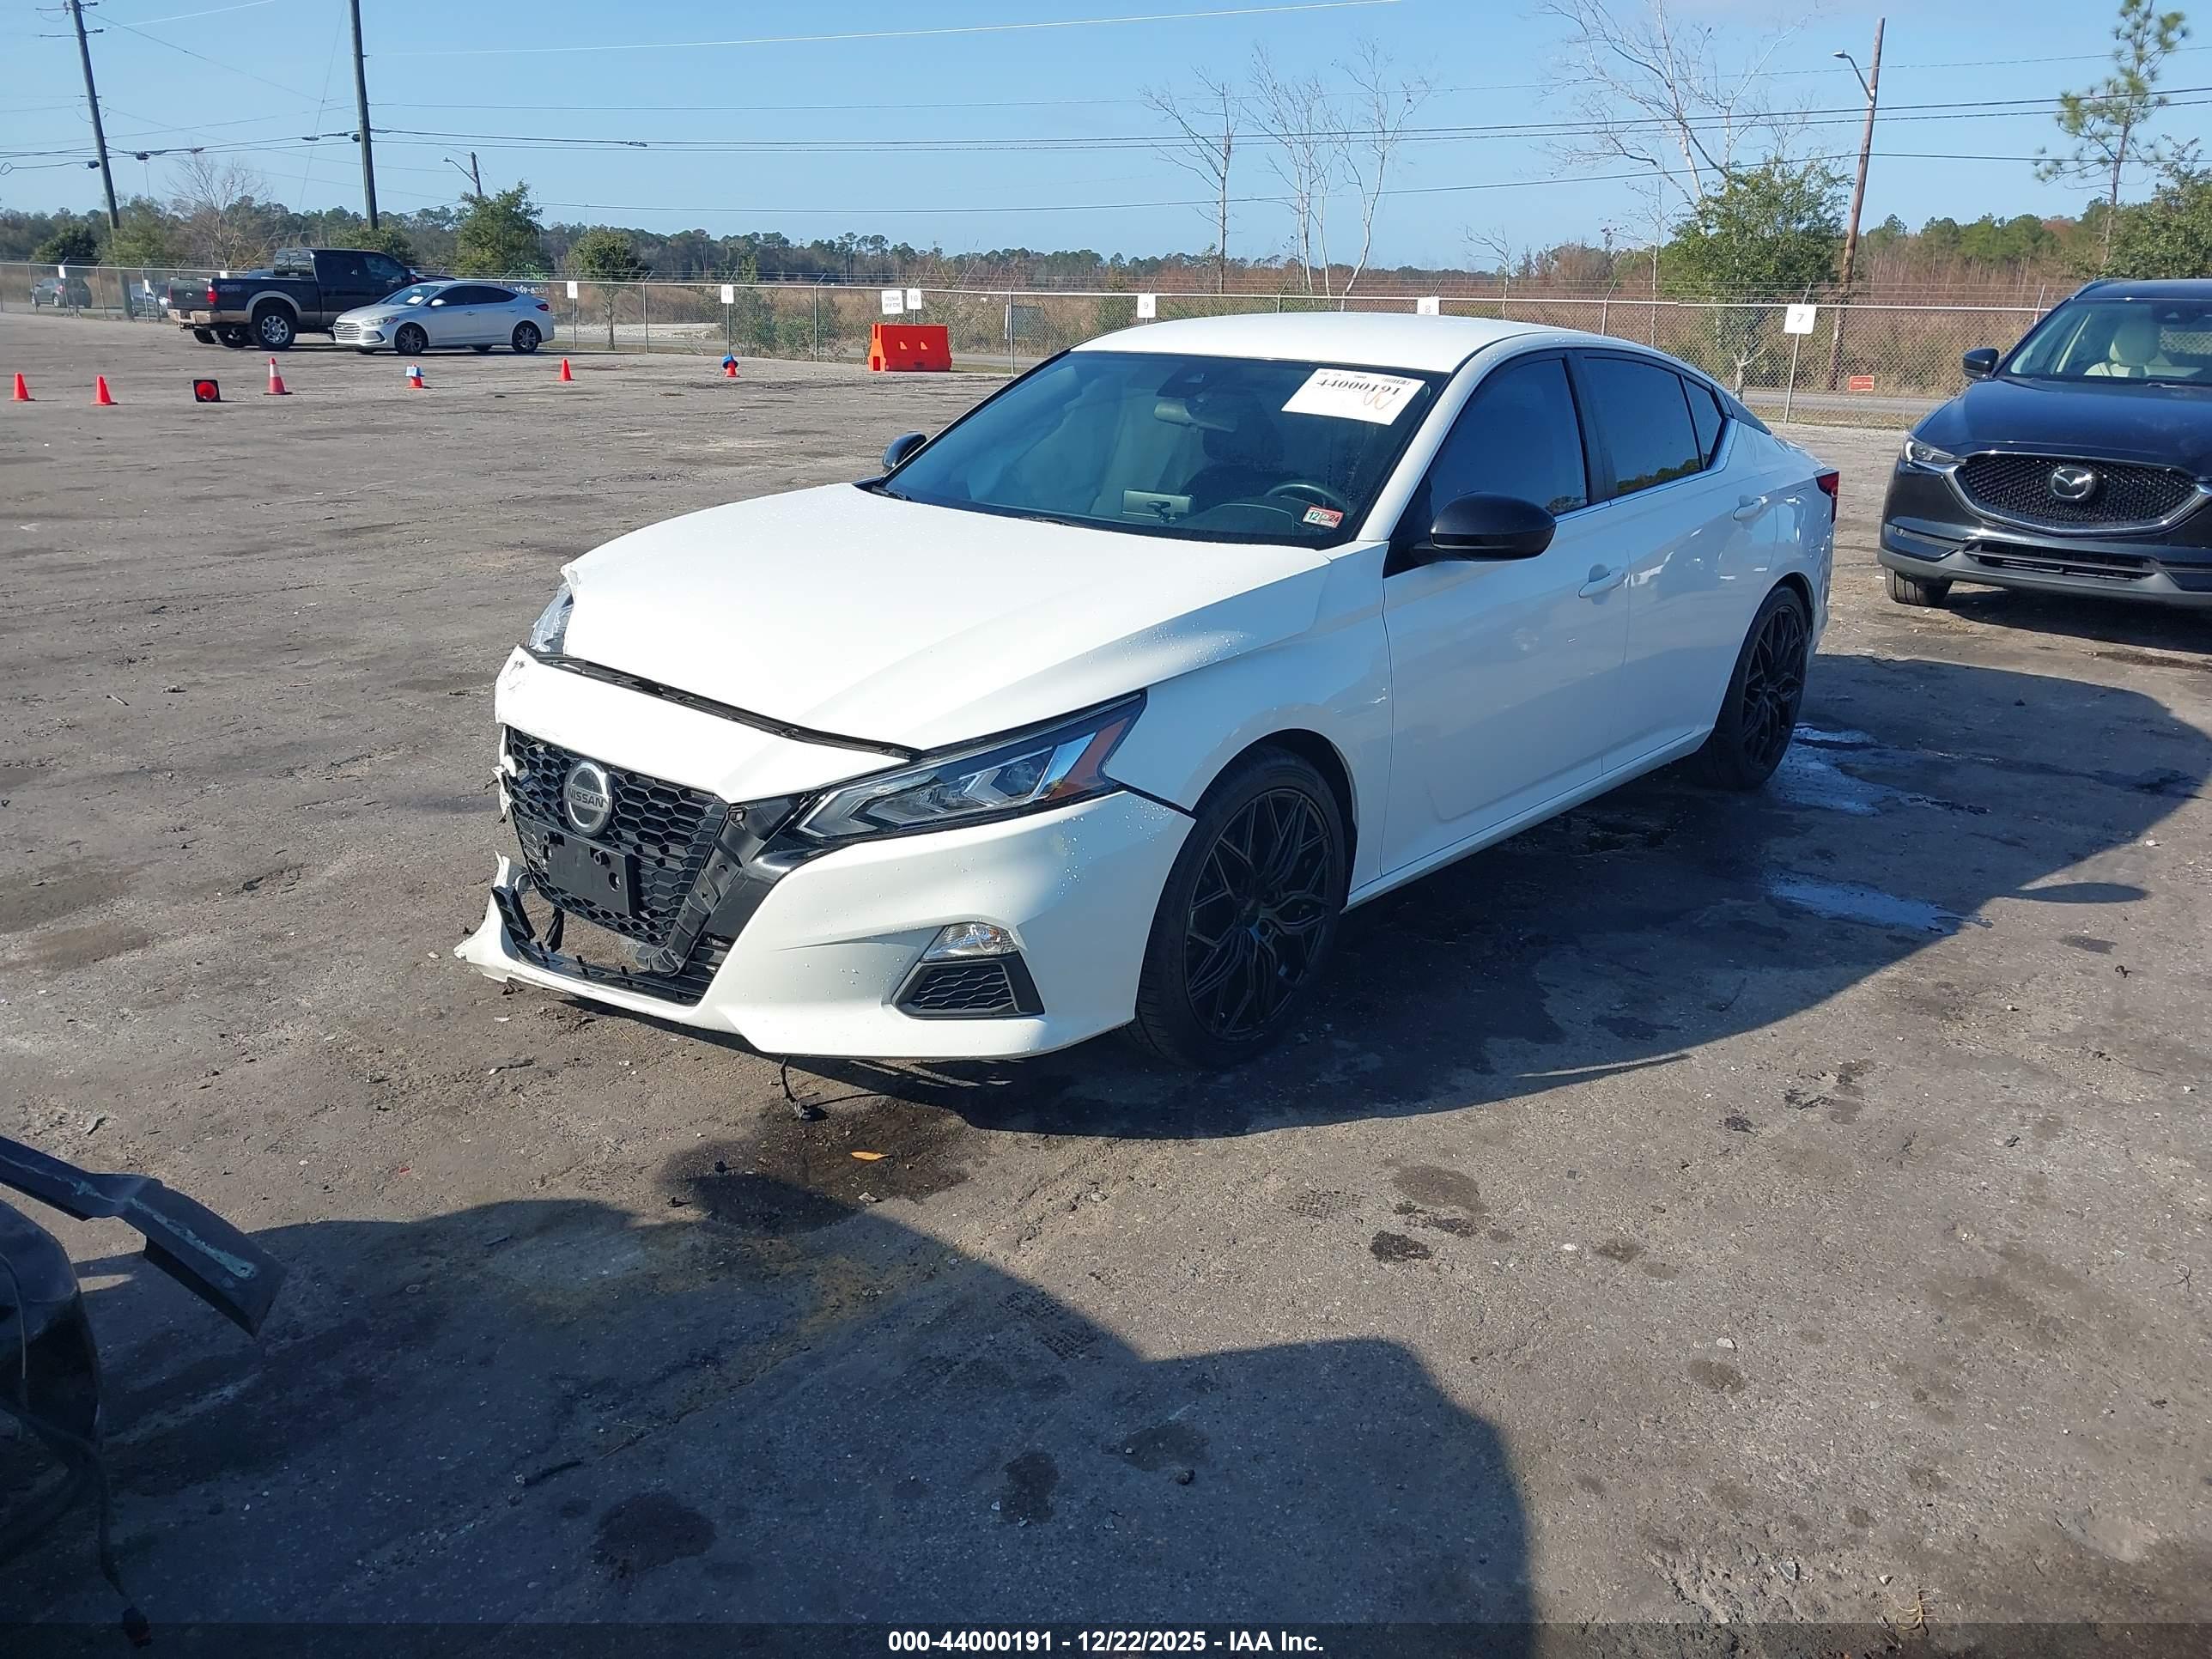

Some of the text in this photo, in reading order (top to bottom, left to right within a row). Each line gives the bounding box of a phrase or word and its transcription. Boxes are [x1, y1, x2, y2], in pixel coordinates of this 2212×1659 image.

[1796, 313, 1805, 323] 7
[1316, 379, 1401, 395] 44000191
[1309, 511, 1321, 521] 12
[1328, 514, 1340, 523] 24
[568, 788, 604, 808] NISSAN
